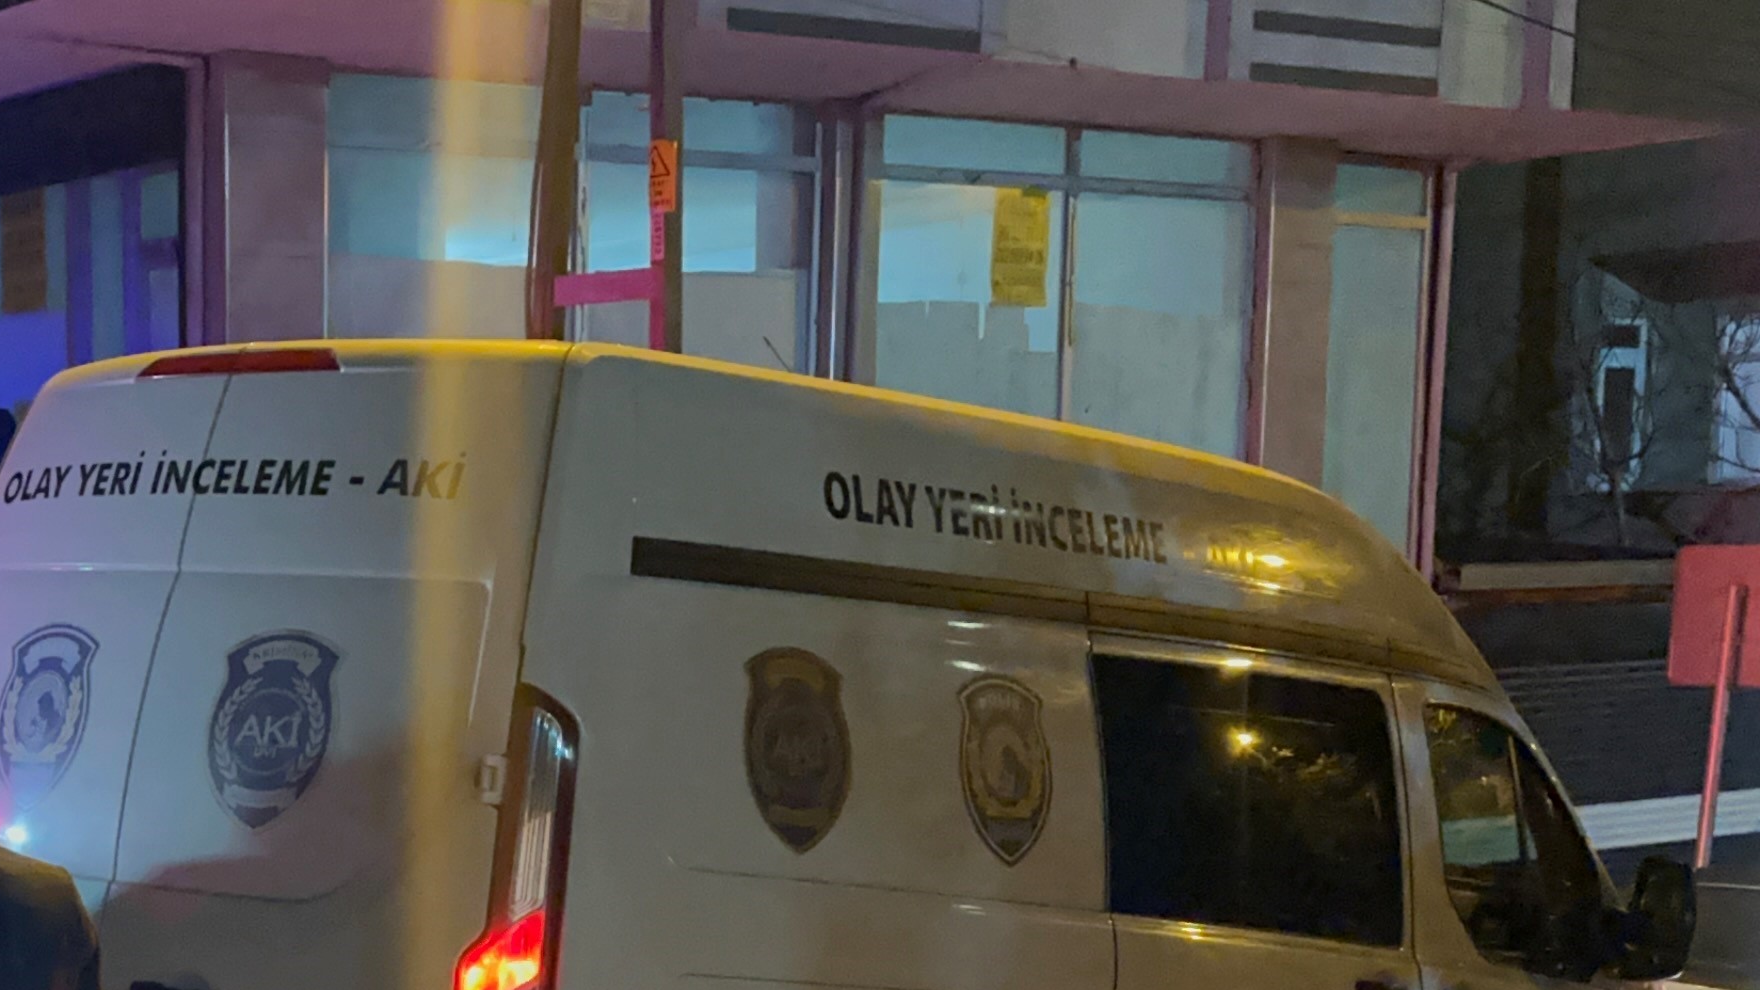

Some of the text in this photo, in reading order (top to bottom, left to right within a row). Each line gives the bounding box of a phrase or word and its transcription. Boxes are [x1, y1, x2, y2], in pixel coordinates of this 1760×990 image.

[3, 464, 71, 504] OLAY
[77, 451, 146, 498] YERİ
[150, 450, 336, 497] İNCELEME
[376, 451, 468, 500] AKİ
[823, 470, 918, 529] OLAY
[924, 483, 1004, 541] YERİ
[1010, 487, 1168, 565] İNCELEME
